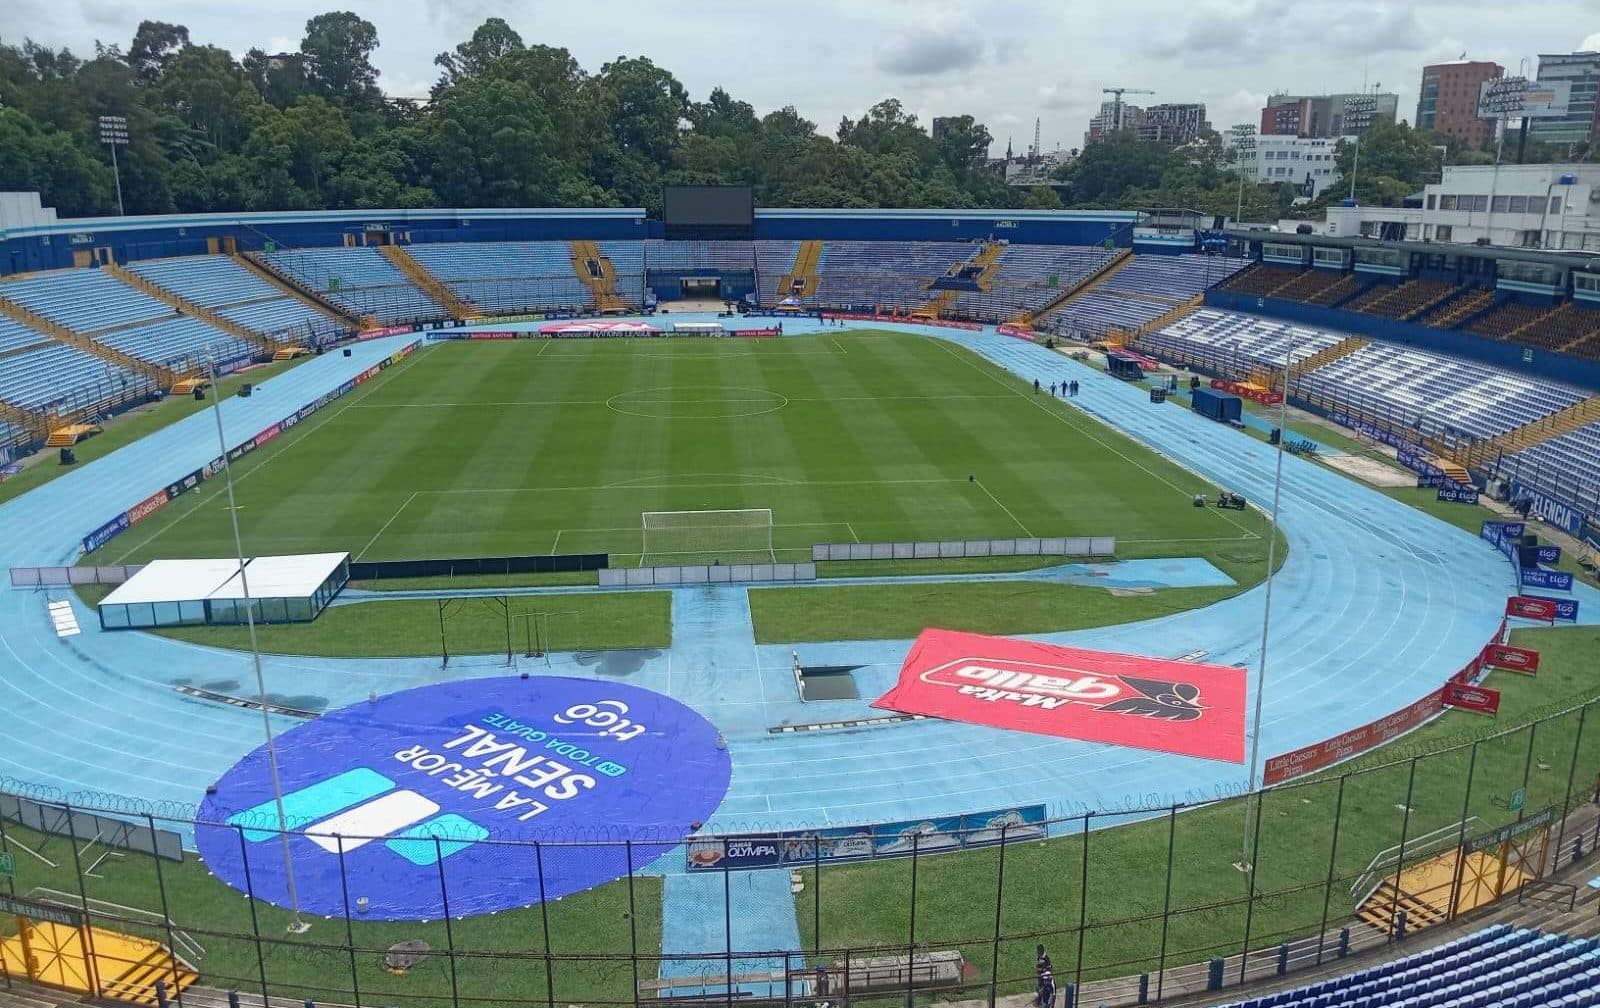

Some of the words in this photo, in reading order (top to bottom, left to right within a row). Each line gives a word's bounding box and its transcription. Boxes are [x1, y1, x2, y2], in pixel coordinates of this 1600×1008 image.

[1439, 490, 1457, 500] tigo
[1459, 492, 1477, 502] tigo
[1539, 549, 1557, 560] tigo
[1549, 574, 1569, 587] tigo
[955, 665, 1120, 698] gallo
[959, 685, 1072, 709] Malta
[482, 712, 548, 743] GUATE
[562, 702, 647, 742] tigo
[443, 724, 596, 800] SEÑAL
[545, 738, 600, 767] TODA
[1269, 756, 1290, 771] Little
[1289, 750, 1318, 765] Caesars
[394, 745, 504, 800] MEJOR
[600, 762, 623, 775] EN
[494, 790, 550, 822] LA
[727, 846, 777, 857] OLYMPIA
